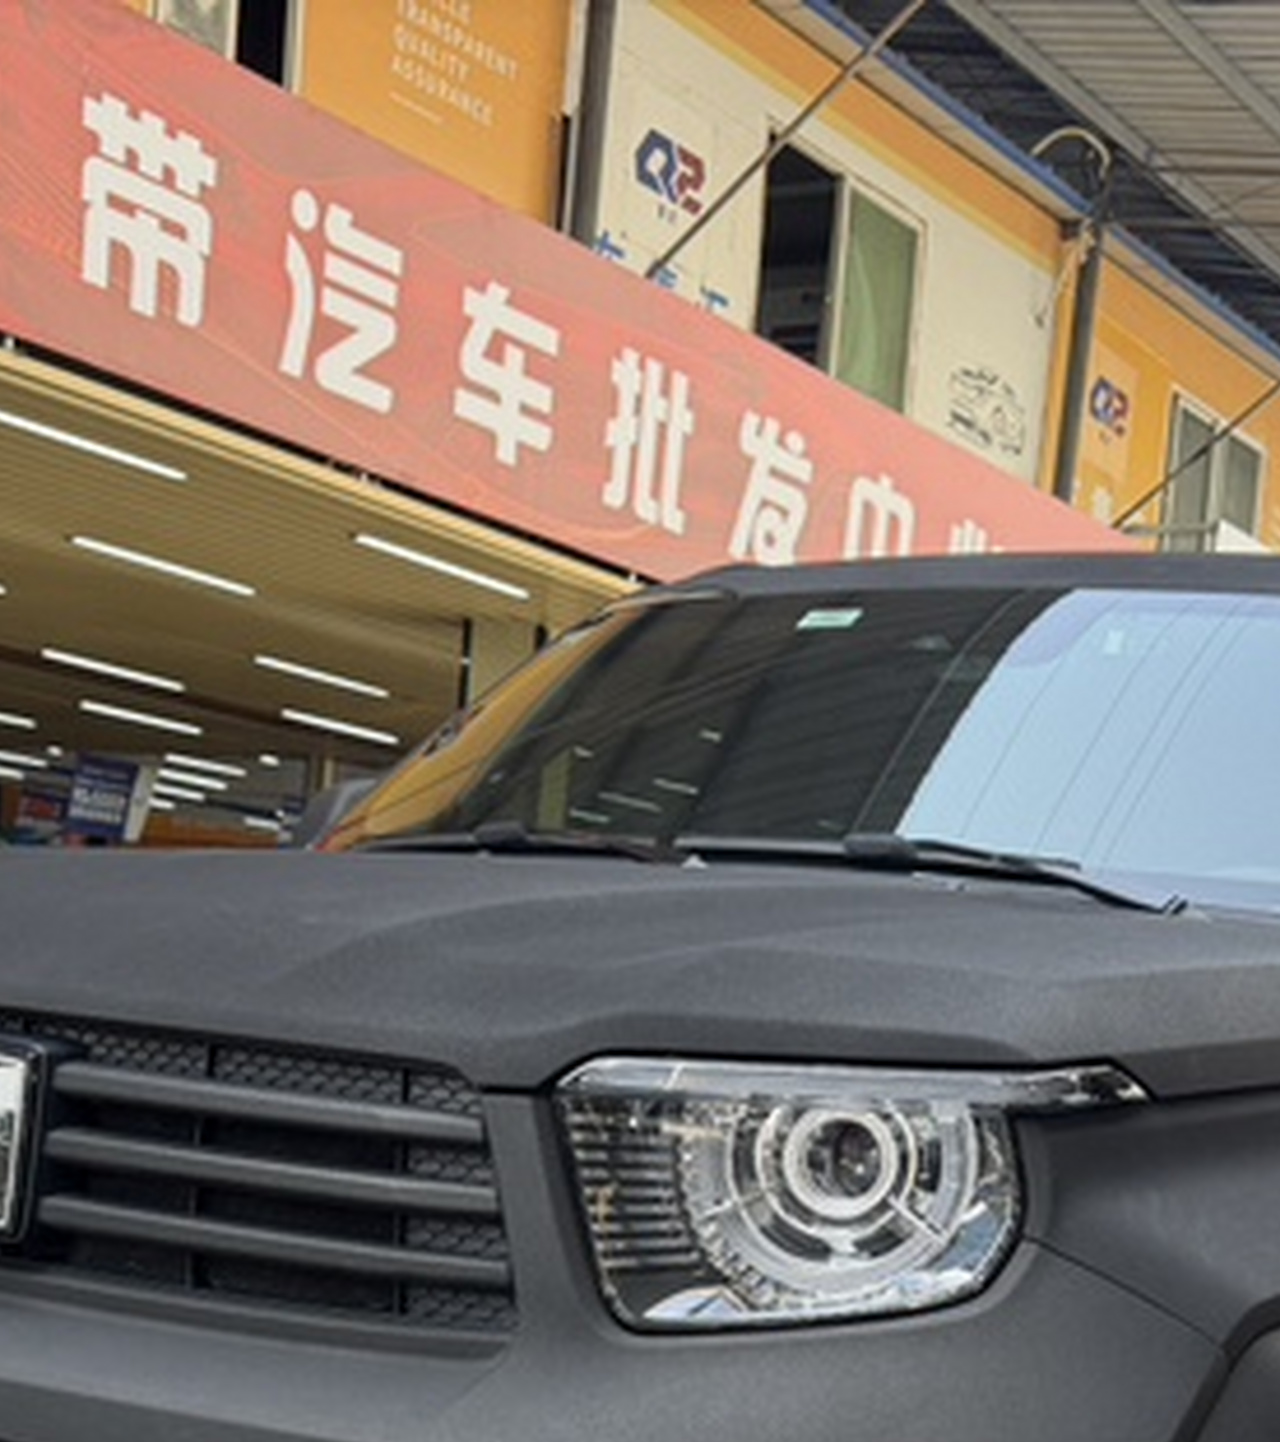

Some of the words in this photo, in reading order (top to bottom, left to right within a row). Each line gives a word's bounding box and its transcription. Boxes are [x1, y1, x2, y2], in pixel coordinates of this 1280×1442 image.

[392, 21, 470, 83] QUALITY
[397, 0, 518, 82] TRANSPARENT
[391, 53, 493, 127] ASSURANCE
